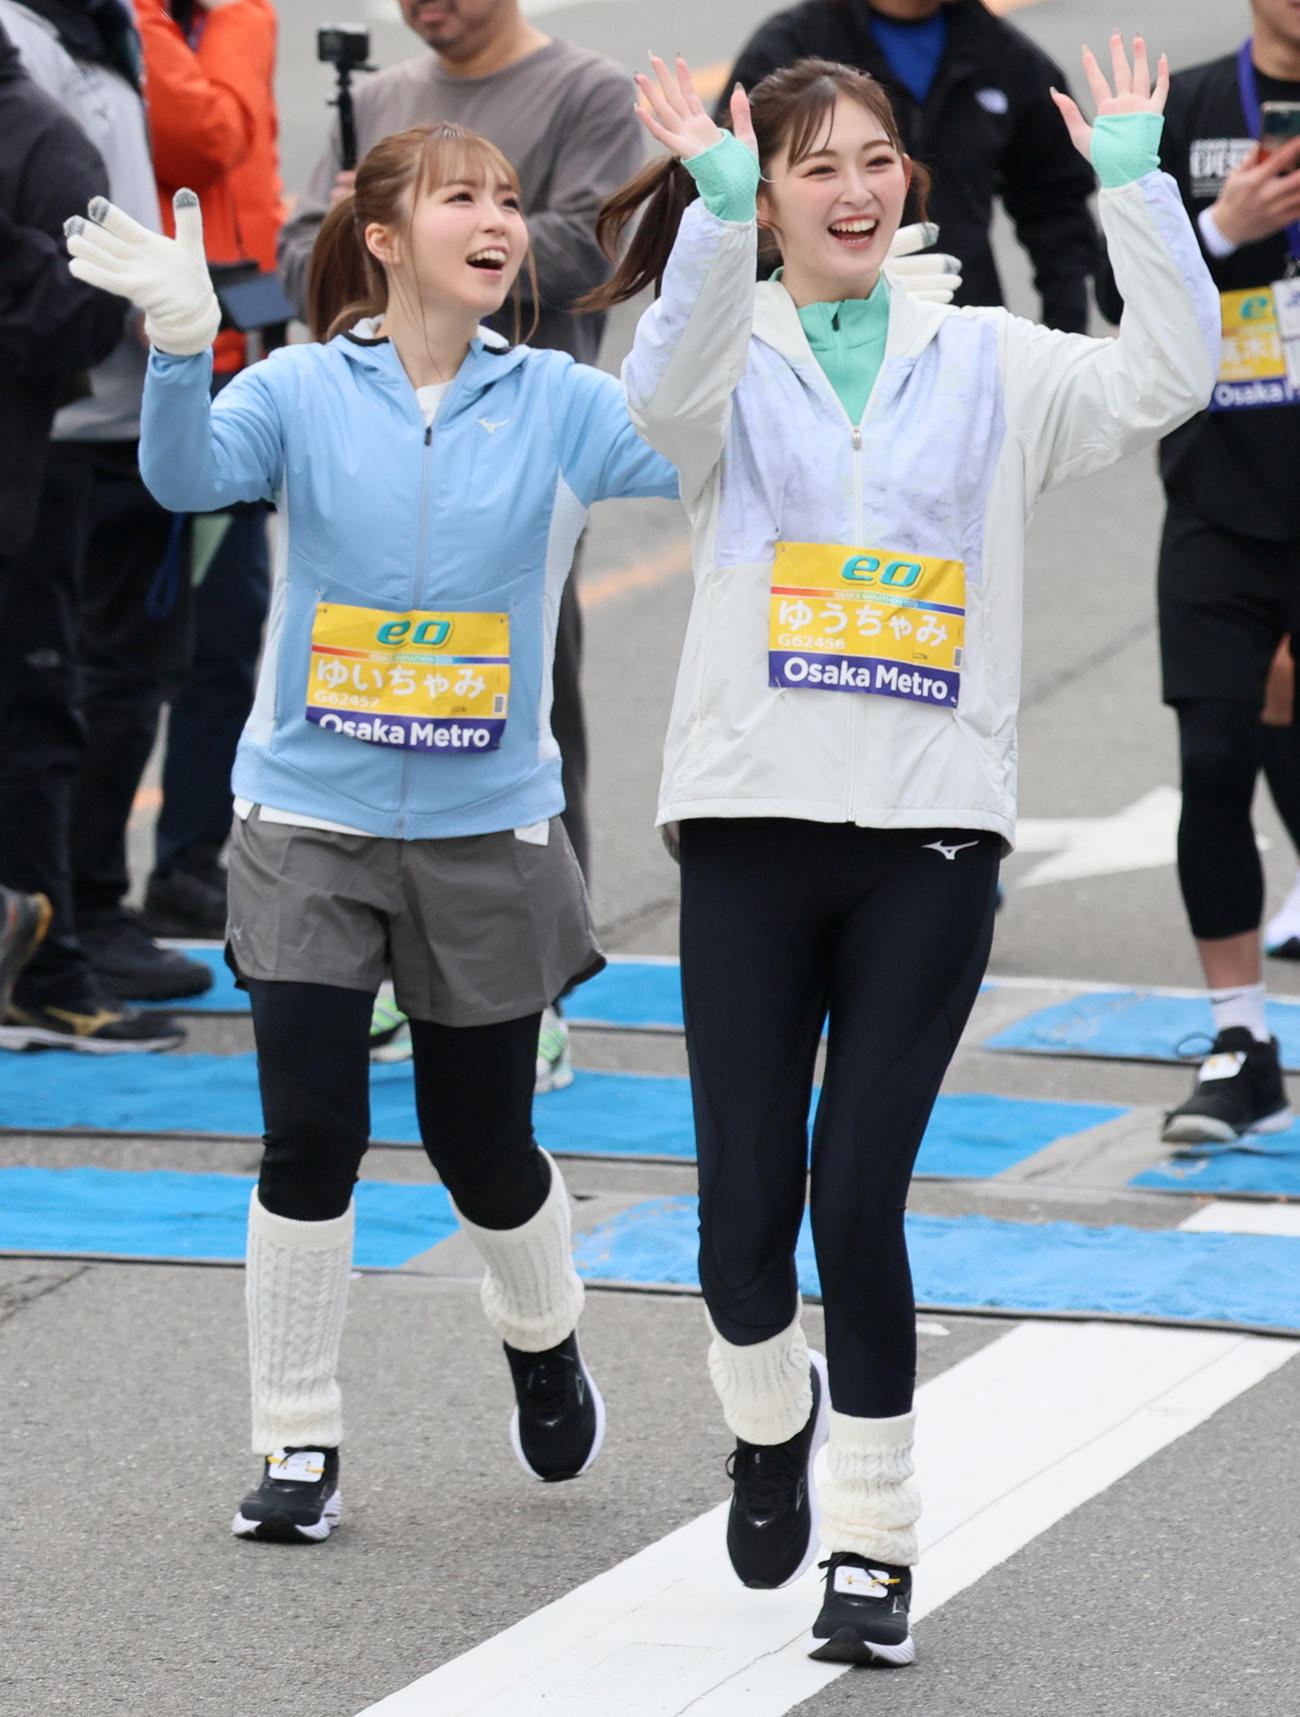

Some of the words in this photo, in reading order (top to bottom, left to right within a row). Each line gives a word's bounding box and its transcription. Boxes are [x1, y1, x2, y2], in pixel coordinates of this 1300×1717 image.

[1215, 380, 1284, 407] Osaka
[841, 555, 922, 587] eo
[376, 620, 451, 645] eo
[779, 600, 949, 646] ゆうちゃみ
[777, 633, 846, 650] G62456
[316, 659, 486, 699] ゆいちゃみ
[783, 656, 871, 688] Osaka
[874, 664, 949, 700] Metro
[314, 689, 380, 709] G62457
[409, 722, 490, 748] Metro
